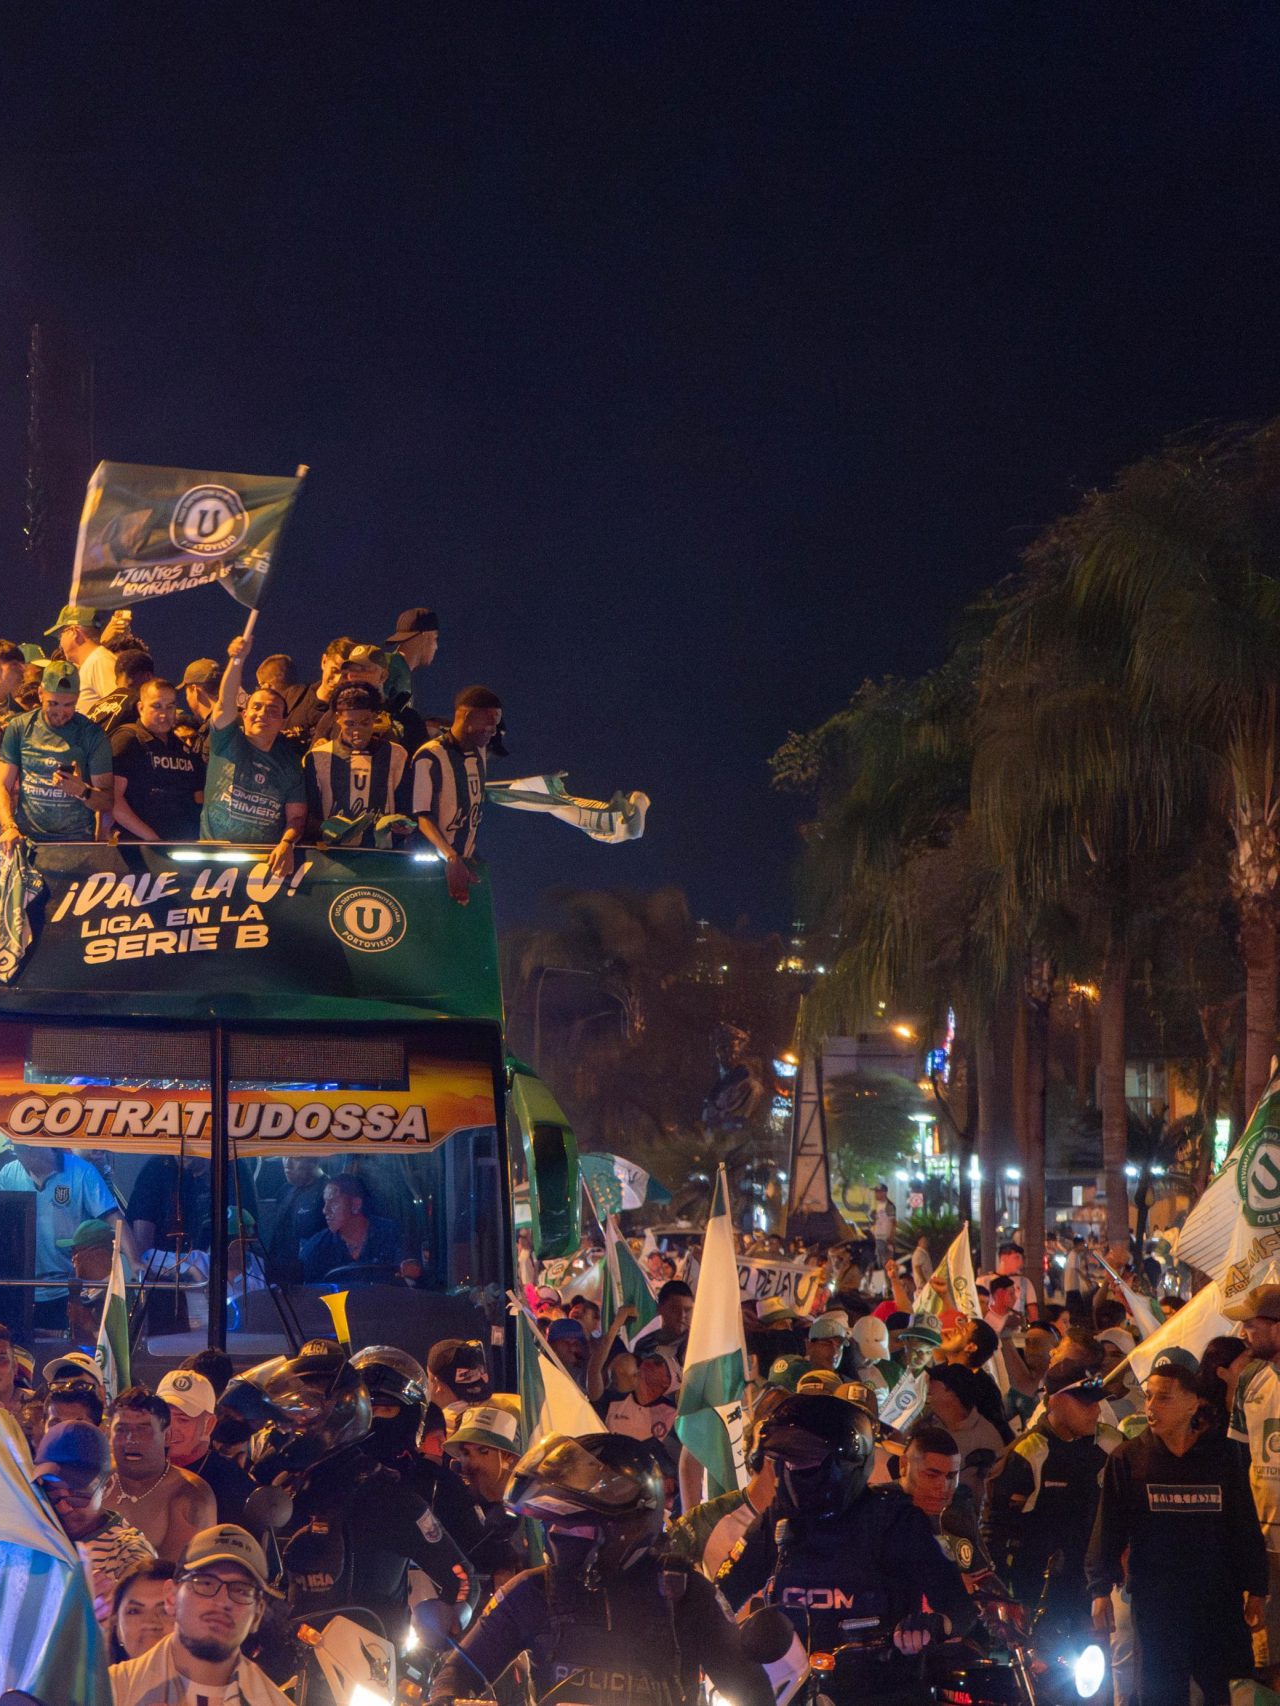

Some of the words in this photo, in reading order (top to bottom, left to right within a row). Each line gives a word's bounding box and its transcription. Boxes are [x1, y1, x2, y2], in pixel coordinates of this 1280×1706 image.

[153, 756, 194, 771] POLICIA
[51, 872, 181, 923] ¡DALE
[190, 867, 239, 901] LA
[80, 912, 155, 938] LIGA
[166, 906, 210, 927] EN
[220, 904, 264, 923] LA
[356, 907, 381, 934] U
[83, 926, 220, 965] SERIE
[234, 924, 270, 949] B
[341, 930, 394, 948] PORTOVIEJO
[9, 1098, 431, 1143] COTRATUDOSSA
[755, 1269, 776, 1299] DE
[775, 1270, 791, 1297] LA
[794, 1273, 816, 1306] U
